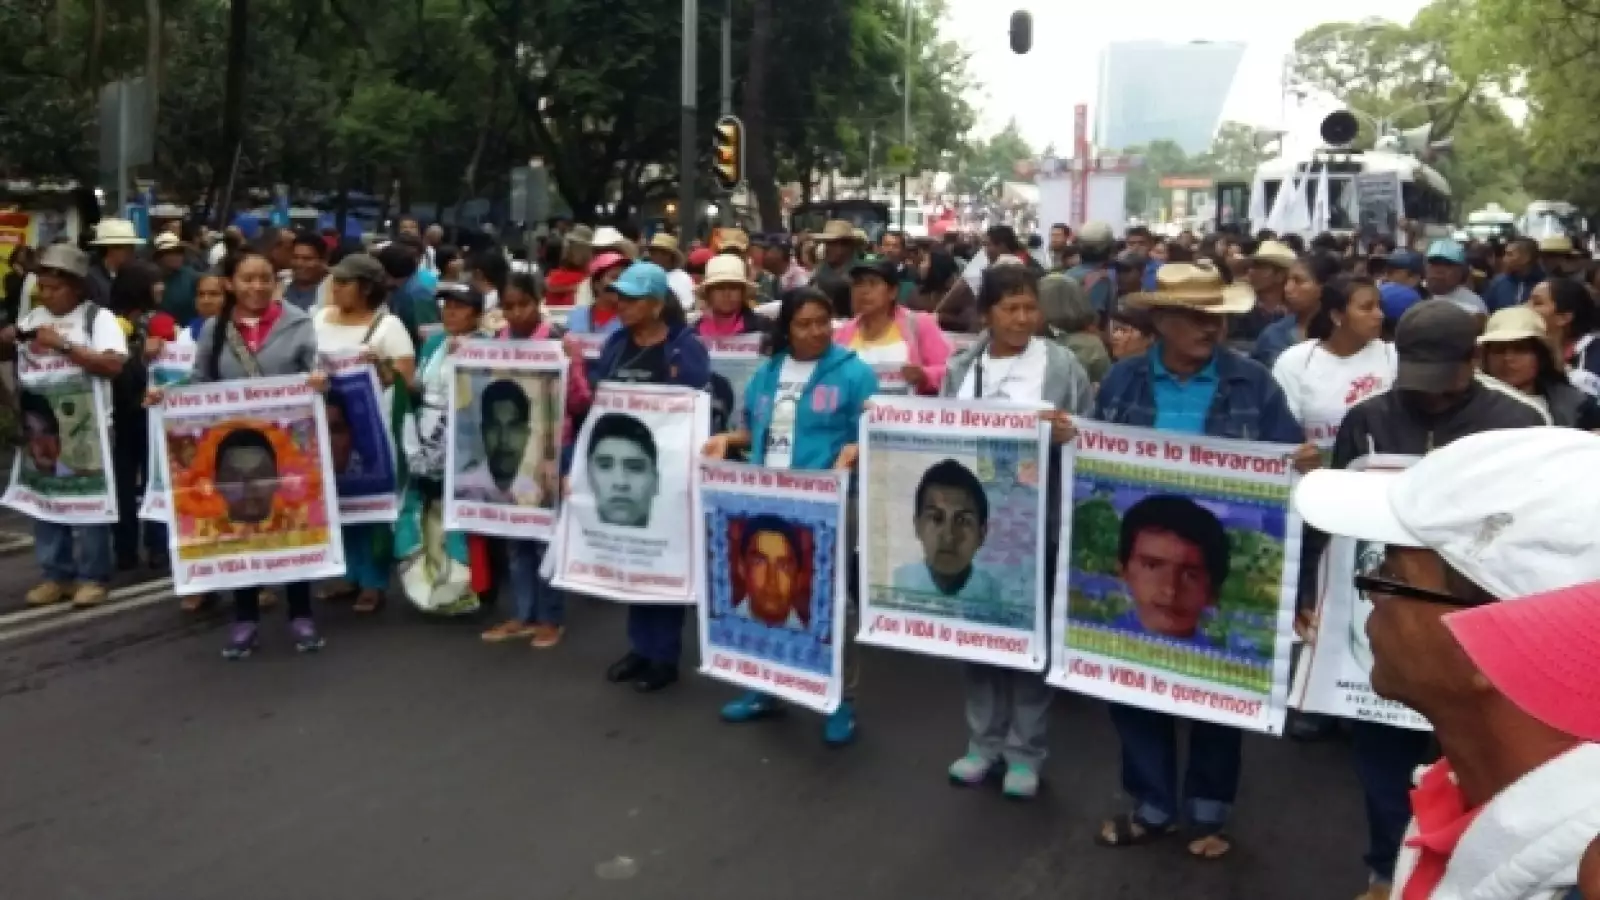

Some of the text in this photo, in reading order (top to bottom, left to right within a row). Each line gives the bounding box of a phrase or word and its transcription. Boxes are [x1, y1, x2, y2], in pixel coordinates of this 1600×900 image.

[917, 408, 935, 424] se
[940, 407, 955, 424] lo
[961, 408, 1038, 429] llevaron!
[1076, 430, 1287, 475] ¡Vivo se lo llevaron!
[741, 472, 756, 485] se
[760, 472, 773, 486] lo
[904, 617, 935, 638] VIDA
[939, 622, 952, 642] lo
[1108, 664, 1147, 690] VIDA
[1151, 675, 1168, 695] lo
[1171, 683, 1263, 718] queremos!
